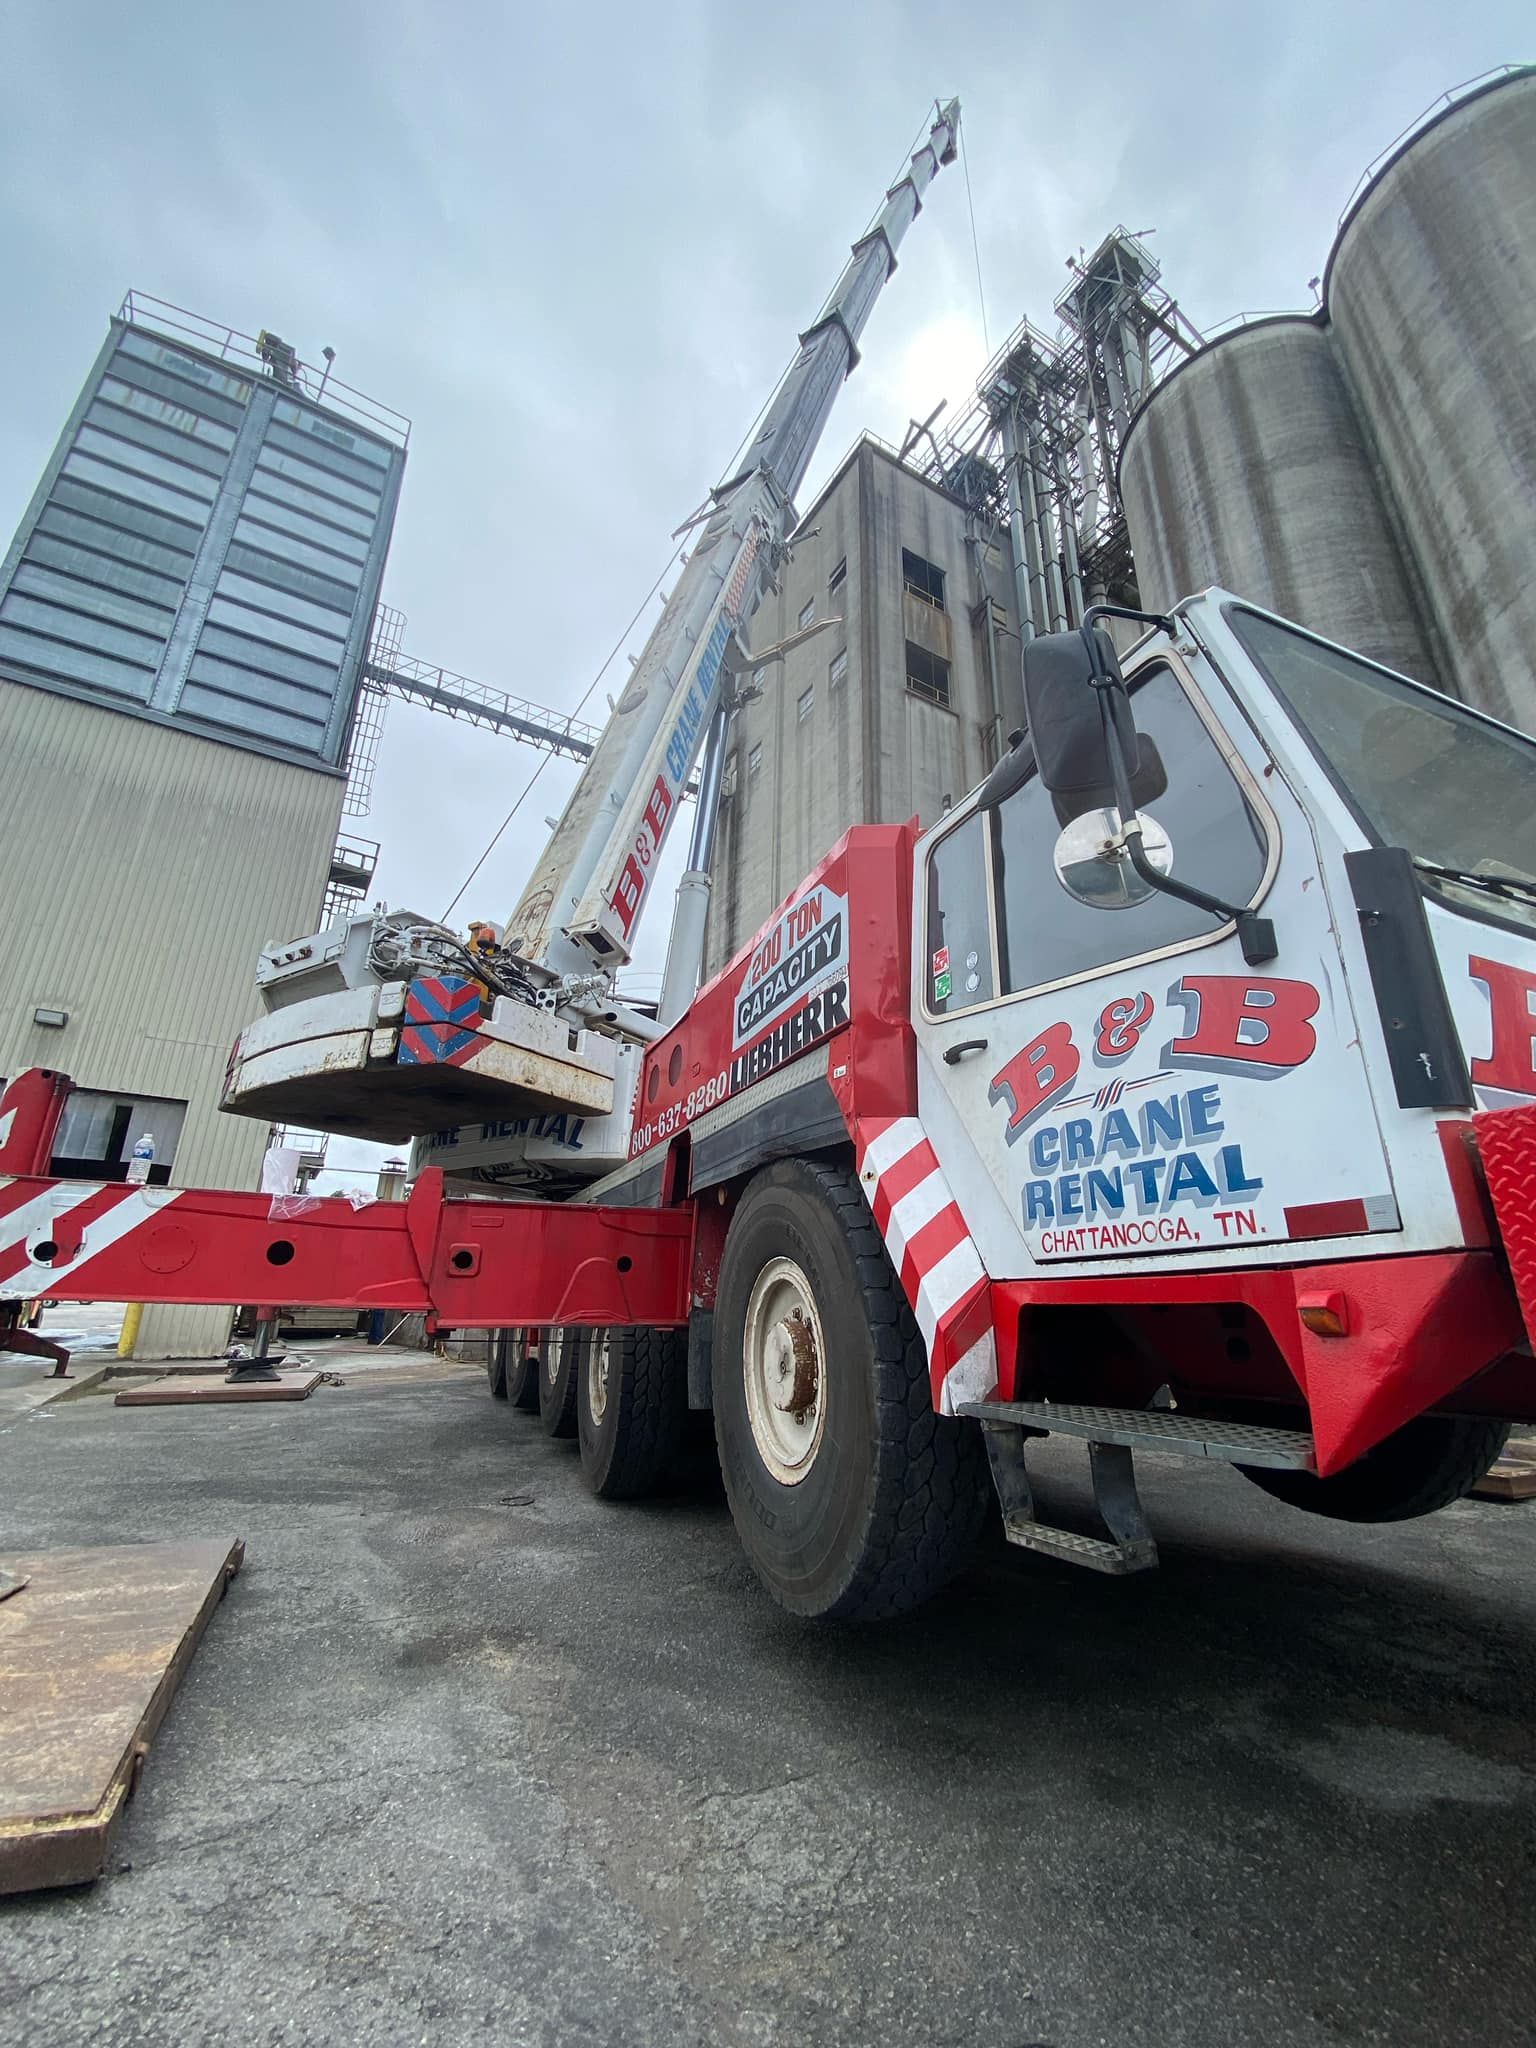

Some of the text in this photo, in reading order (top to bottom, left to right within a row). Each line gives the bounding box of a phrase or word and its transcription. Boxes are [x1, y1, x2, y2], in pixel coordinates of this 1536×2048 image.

[666, 687, 703, 783] CRANE
[697, 613, 732, 700] RENTAL
[738, 921, 839, 1030] CAPACITY
[751, 922, 782, 986] 200
[786, 892, 823, 948] TON
[730, 980, 849, 1094] LIEBHERR
[1028, 1083, 1225, 1176] CRANE
[1022, 1144, 1264, 1231] RENTAL
[1041, 1209, 1266, 1254] CHATTANOOGA, TN.
